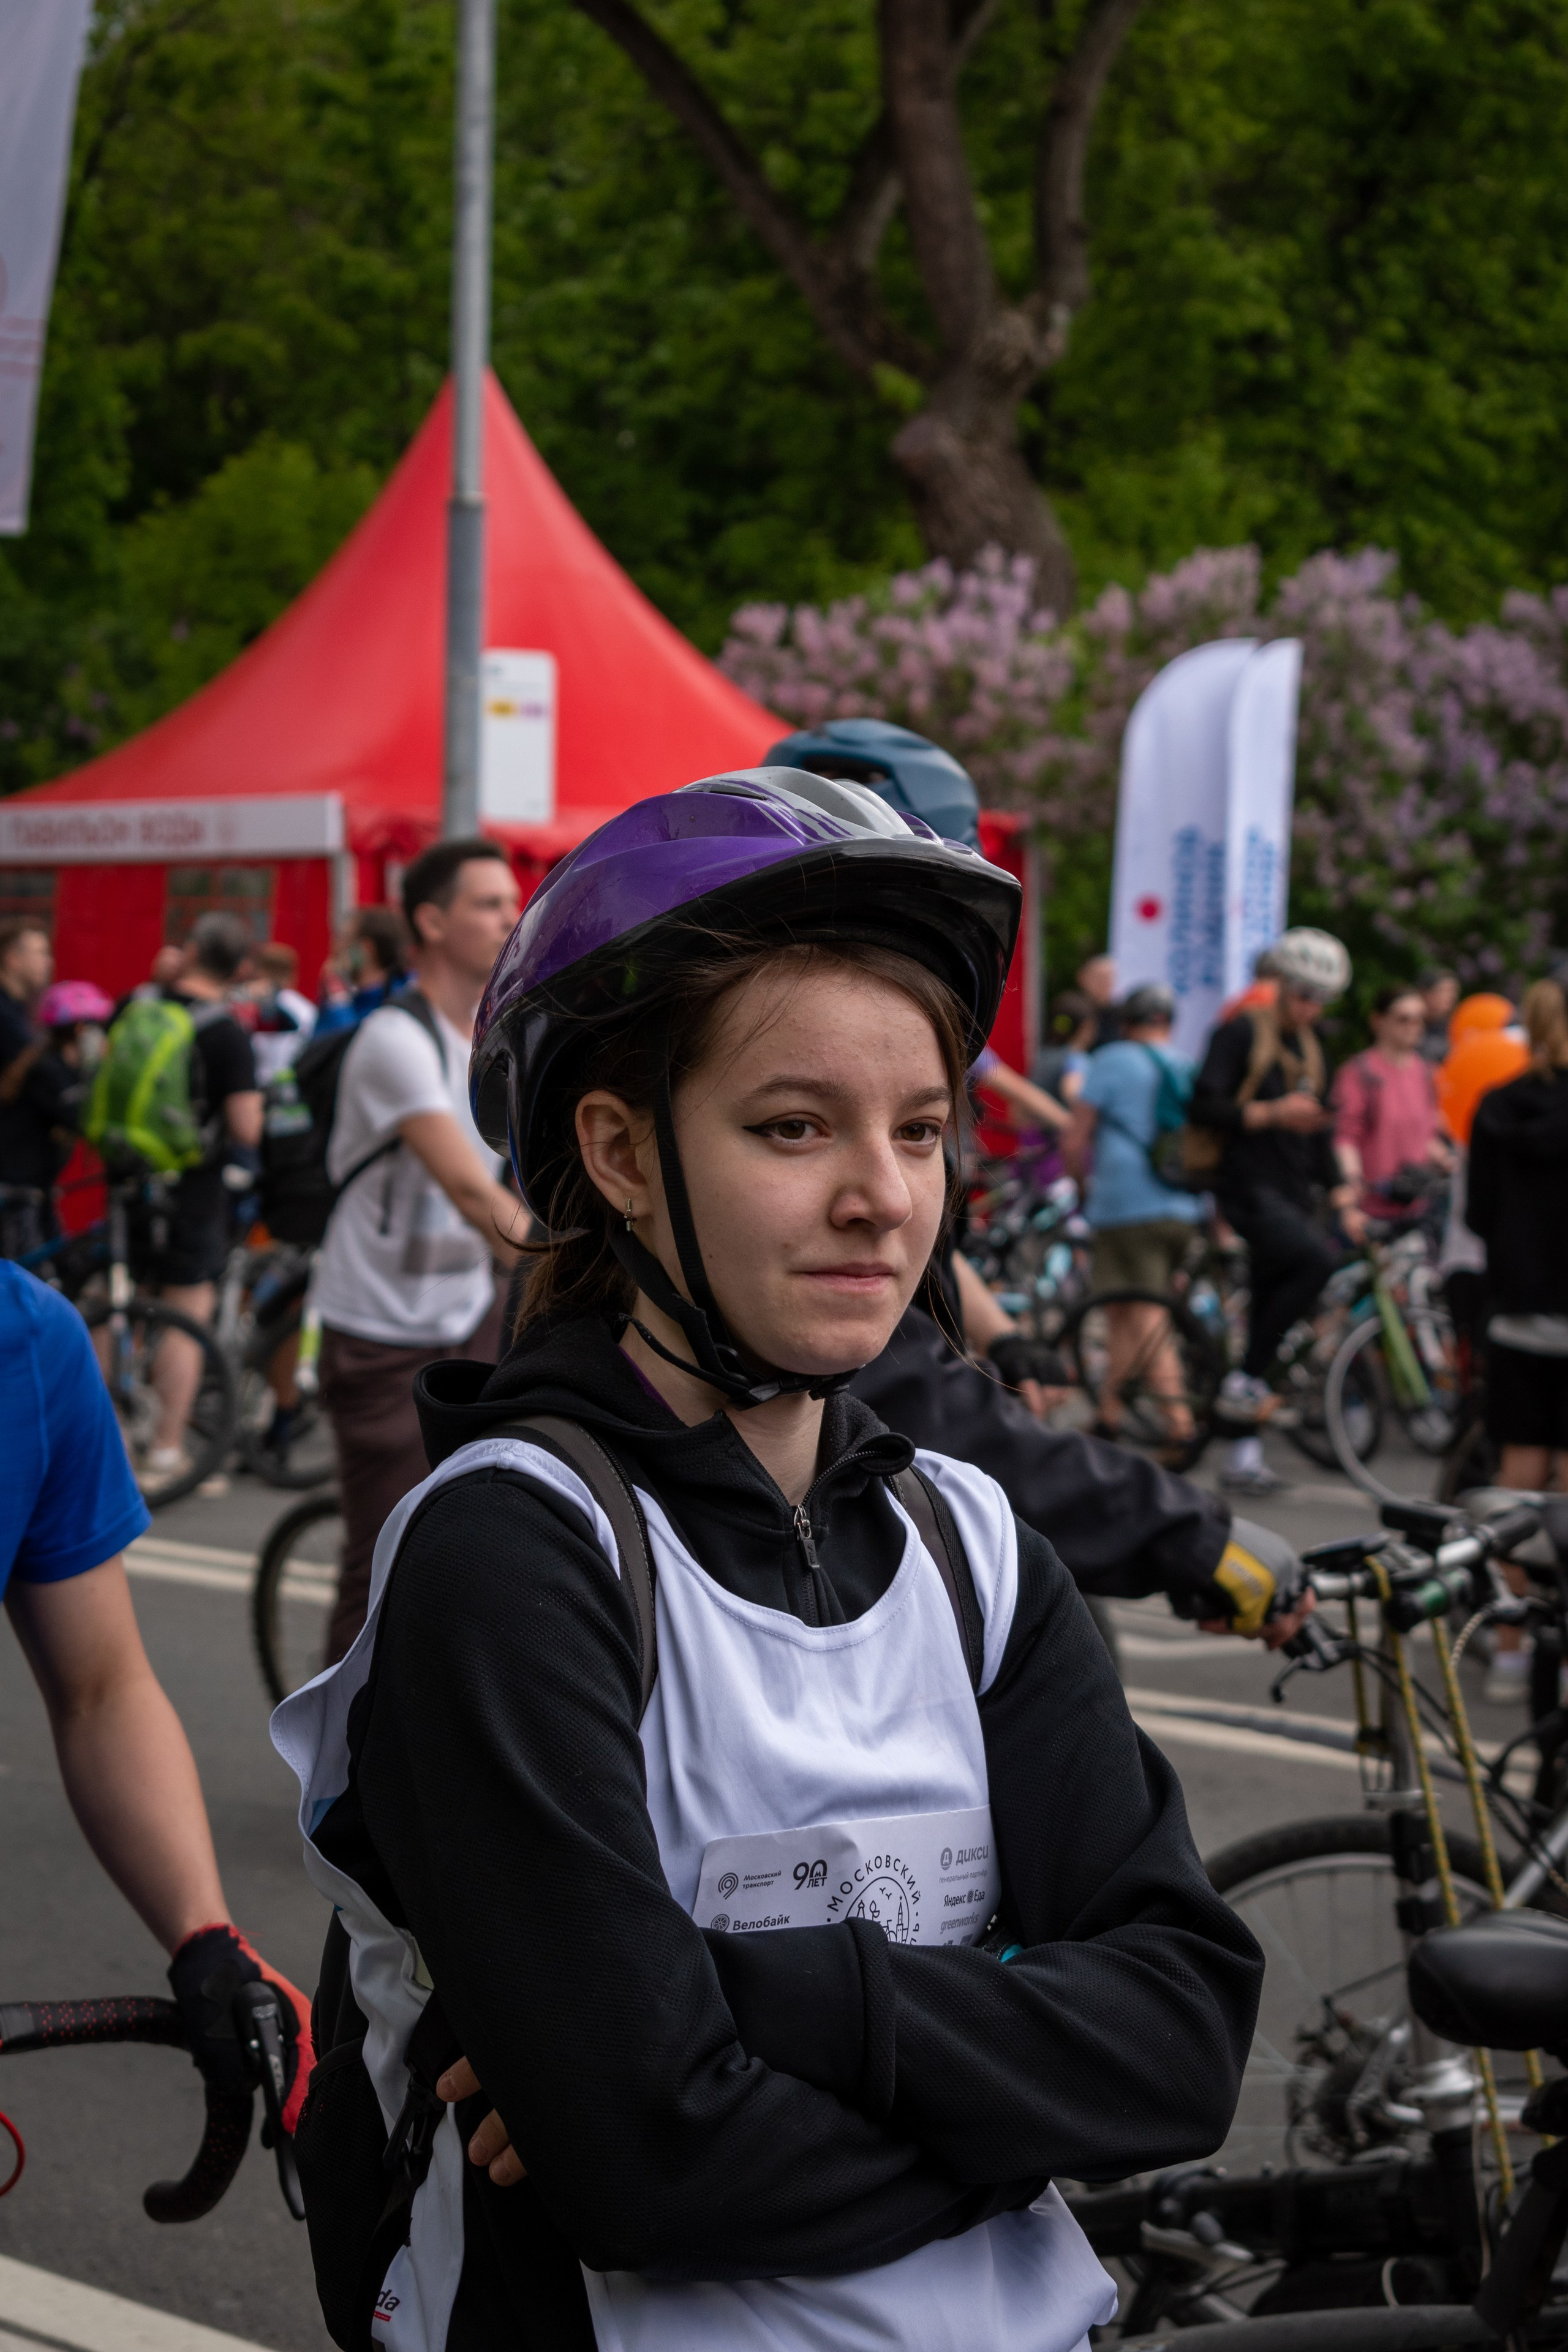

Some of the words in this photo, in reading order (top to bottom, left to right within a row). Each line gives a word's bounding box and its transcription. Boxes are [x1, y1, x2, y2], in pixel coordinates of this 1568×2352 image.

[743, 1870, 782, 1881] Московский
[793, 1859, 827, 1890] 90
[806, 1877, 827, 1888] ЛЕТ
[939, 1872, 969, 1883] генеральный
[969, 1869, 987, 1879] партнёр
[742, 1879, 774, 1890] транспорт
[827, 1855, 921, 1912] МОСКОВСКИЙ
[943, 1894, 967, 1907] Яндекс
[973, 1889, 986, 1902] Еда
[732, 1914, 791, 1931] Велобайк
[940, 1912, 979, 1935] greenworks
